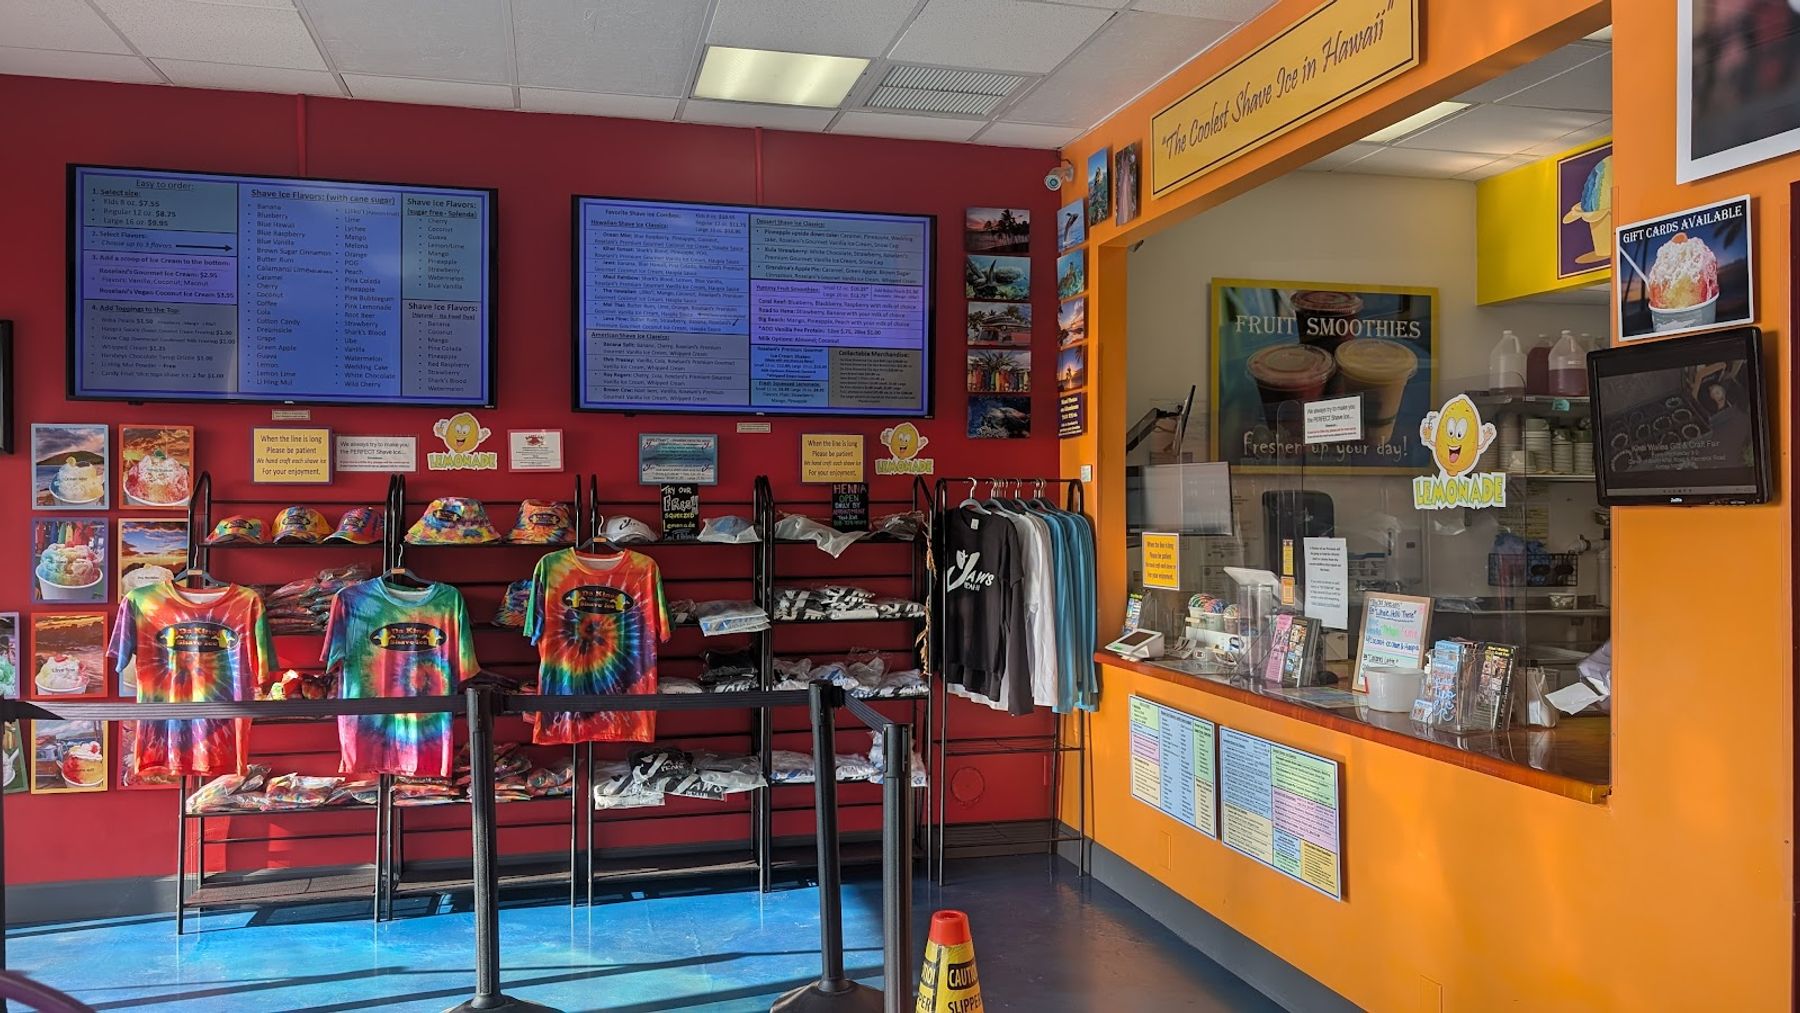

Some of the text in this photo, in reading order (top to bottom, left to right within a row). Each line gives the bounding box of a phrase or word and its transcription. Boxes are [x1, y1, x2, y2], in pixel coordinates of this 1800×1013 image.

[1161, 0, 1395, 161] "The Coolest Shave Ice in Hawaii"
[136, 180, 154, 189] Easy
[251, 189, 277, 198] Shave
[280, 190, 290, 199] Ice
[408, 198, 431, 206] Shave
[1623, 205, 1743, 244] GIFT CARDS AVAILABLE
[408, 302, 433, 310] Shave
[434, 303, 446, 311] Ice
[1234, 315, 1421, 339] FRUIT SMOOTHIES
[309, 436, 322, 445] long
[1243, 431, 1303, 456] Freshen
[1311, 444, 1328, 461] up
[1336, 444, 1369, 462] your
[1376, 435, 1408, 462] day!
[296, 447, 317, 455] patient
[429, 452, 497, 469] LEMONADE
[876, 459, 934, 474] LEMONADE
[833, 483, 867, 495] HENNA
[1414, 476, 1504, 506] LEMONADE
